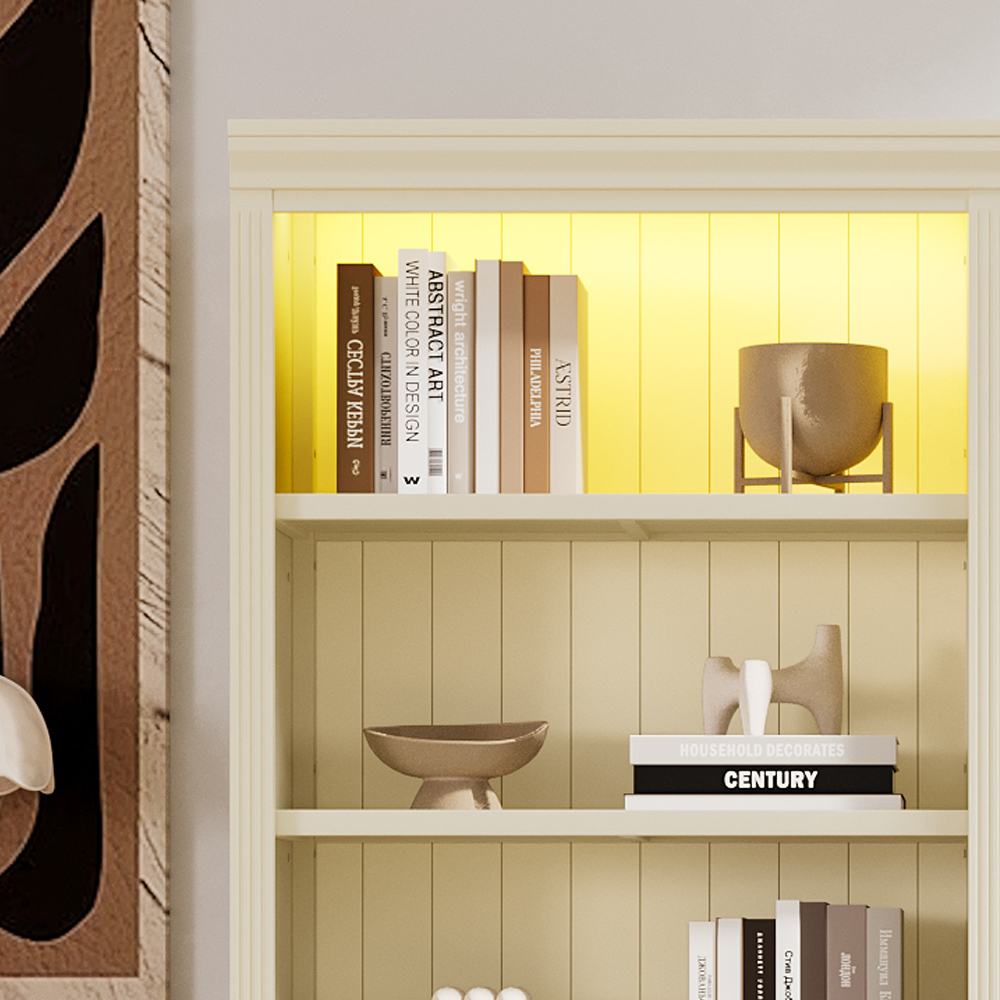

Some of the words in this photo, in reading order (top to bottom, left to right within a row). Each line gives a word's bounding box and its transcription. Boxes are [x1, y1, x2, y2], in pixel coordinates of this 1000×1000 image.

[405, 260, 420, 307] WHITE
[451, 279, 467, 327] wright
[405, 310, 420, 357] COLOR
[428, 269, 444, 362] ABSTRACT
[405, 361, 420, 377] IN
[428, 367, 444, 402] ART
[453, 331, 467, 424] architecture
[530, 347, 542, 428] PHILADELPHIA
[405, 381, 420, 443] DESIGN
[680, 743, 763, 757] HOUSEHOLD
[767, 743, 845, 757] DECORATES
[724, 770, 818, 789] CENTURY
[784, 950, 794, 974] Стив
[877, 929, 892, 986] Иммануил
